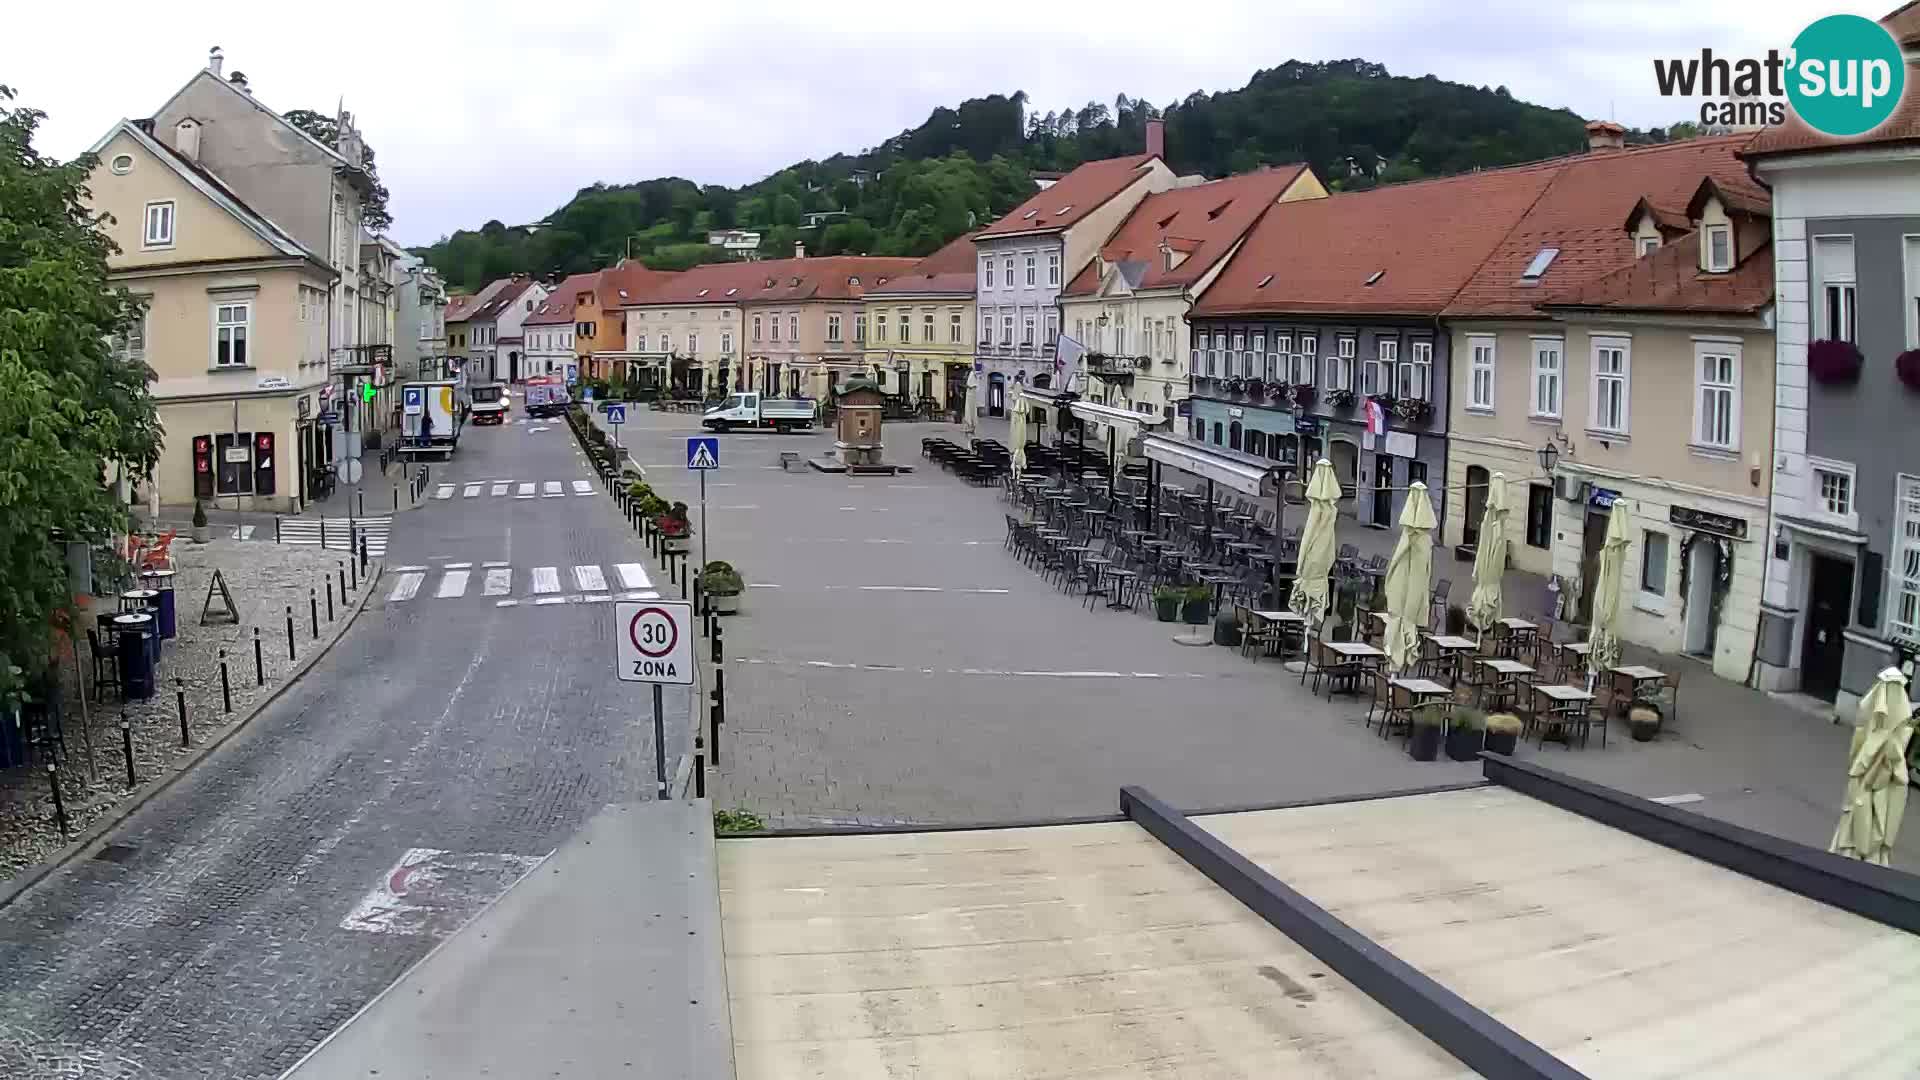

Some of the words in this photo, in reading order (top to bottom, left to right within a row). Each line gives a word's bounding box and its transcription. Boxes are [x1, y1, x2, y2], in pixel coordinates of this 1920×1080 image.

[409, 392, 417, 403] P
[642, 623, 667, 644] 30
[633, 660, 677, 677] ZONA
